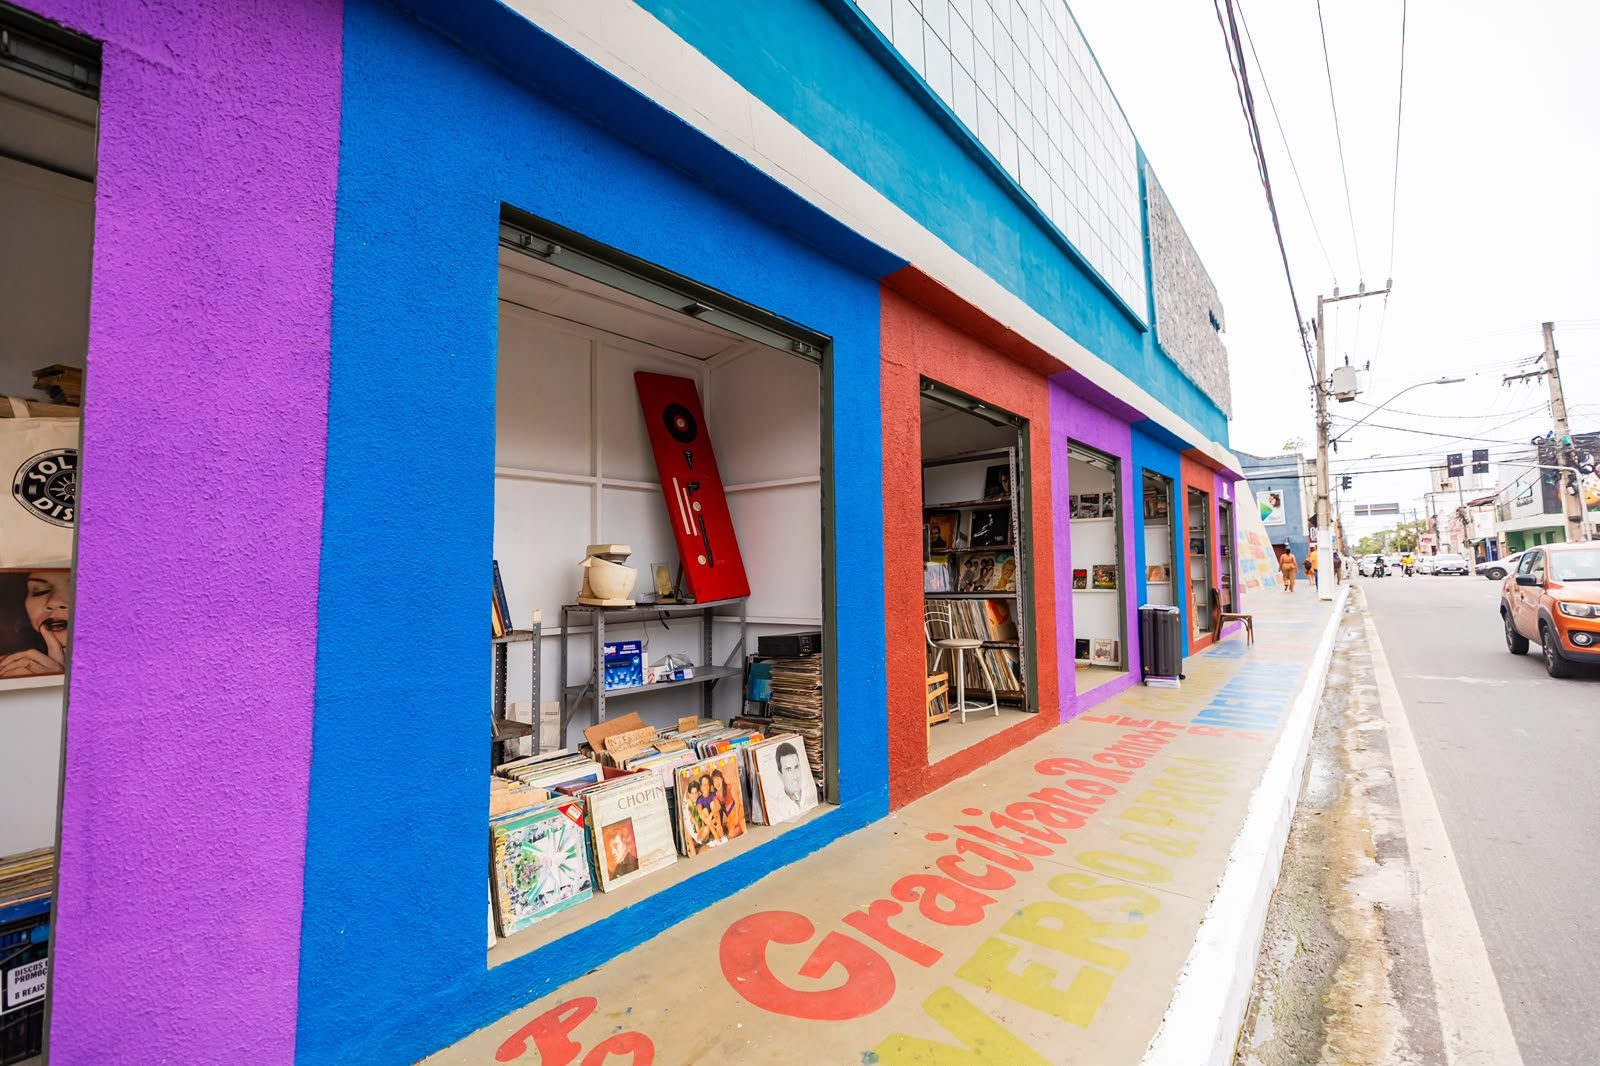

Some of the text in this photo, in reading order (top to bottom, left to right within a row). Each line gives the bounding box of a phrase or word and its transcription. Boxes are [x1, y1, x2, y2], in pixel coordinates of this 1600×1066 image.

[32, 496, 74, 521] DIS
[618, 785, 665, 810] CHOPIN
[719, 728, 1178, 1022] Graciliano Ramos
[15, 961, 43, 977] DISCOS
[15, 967, 48, 985] PROMOÇ
[22, 983, 45, 997] REAIS
